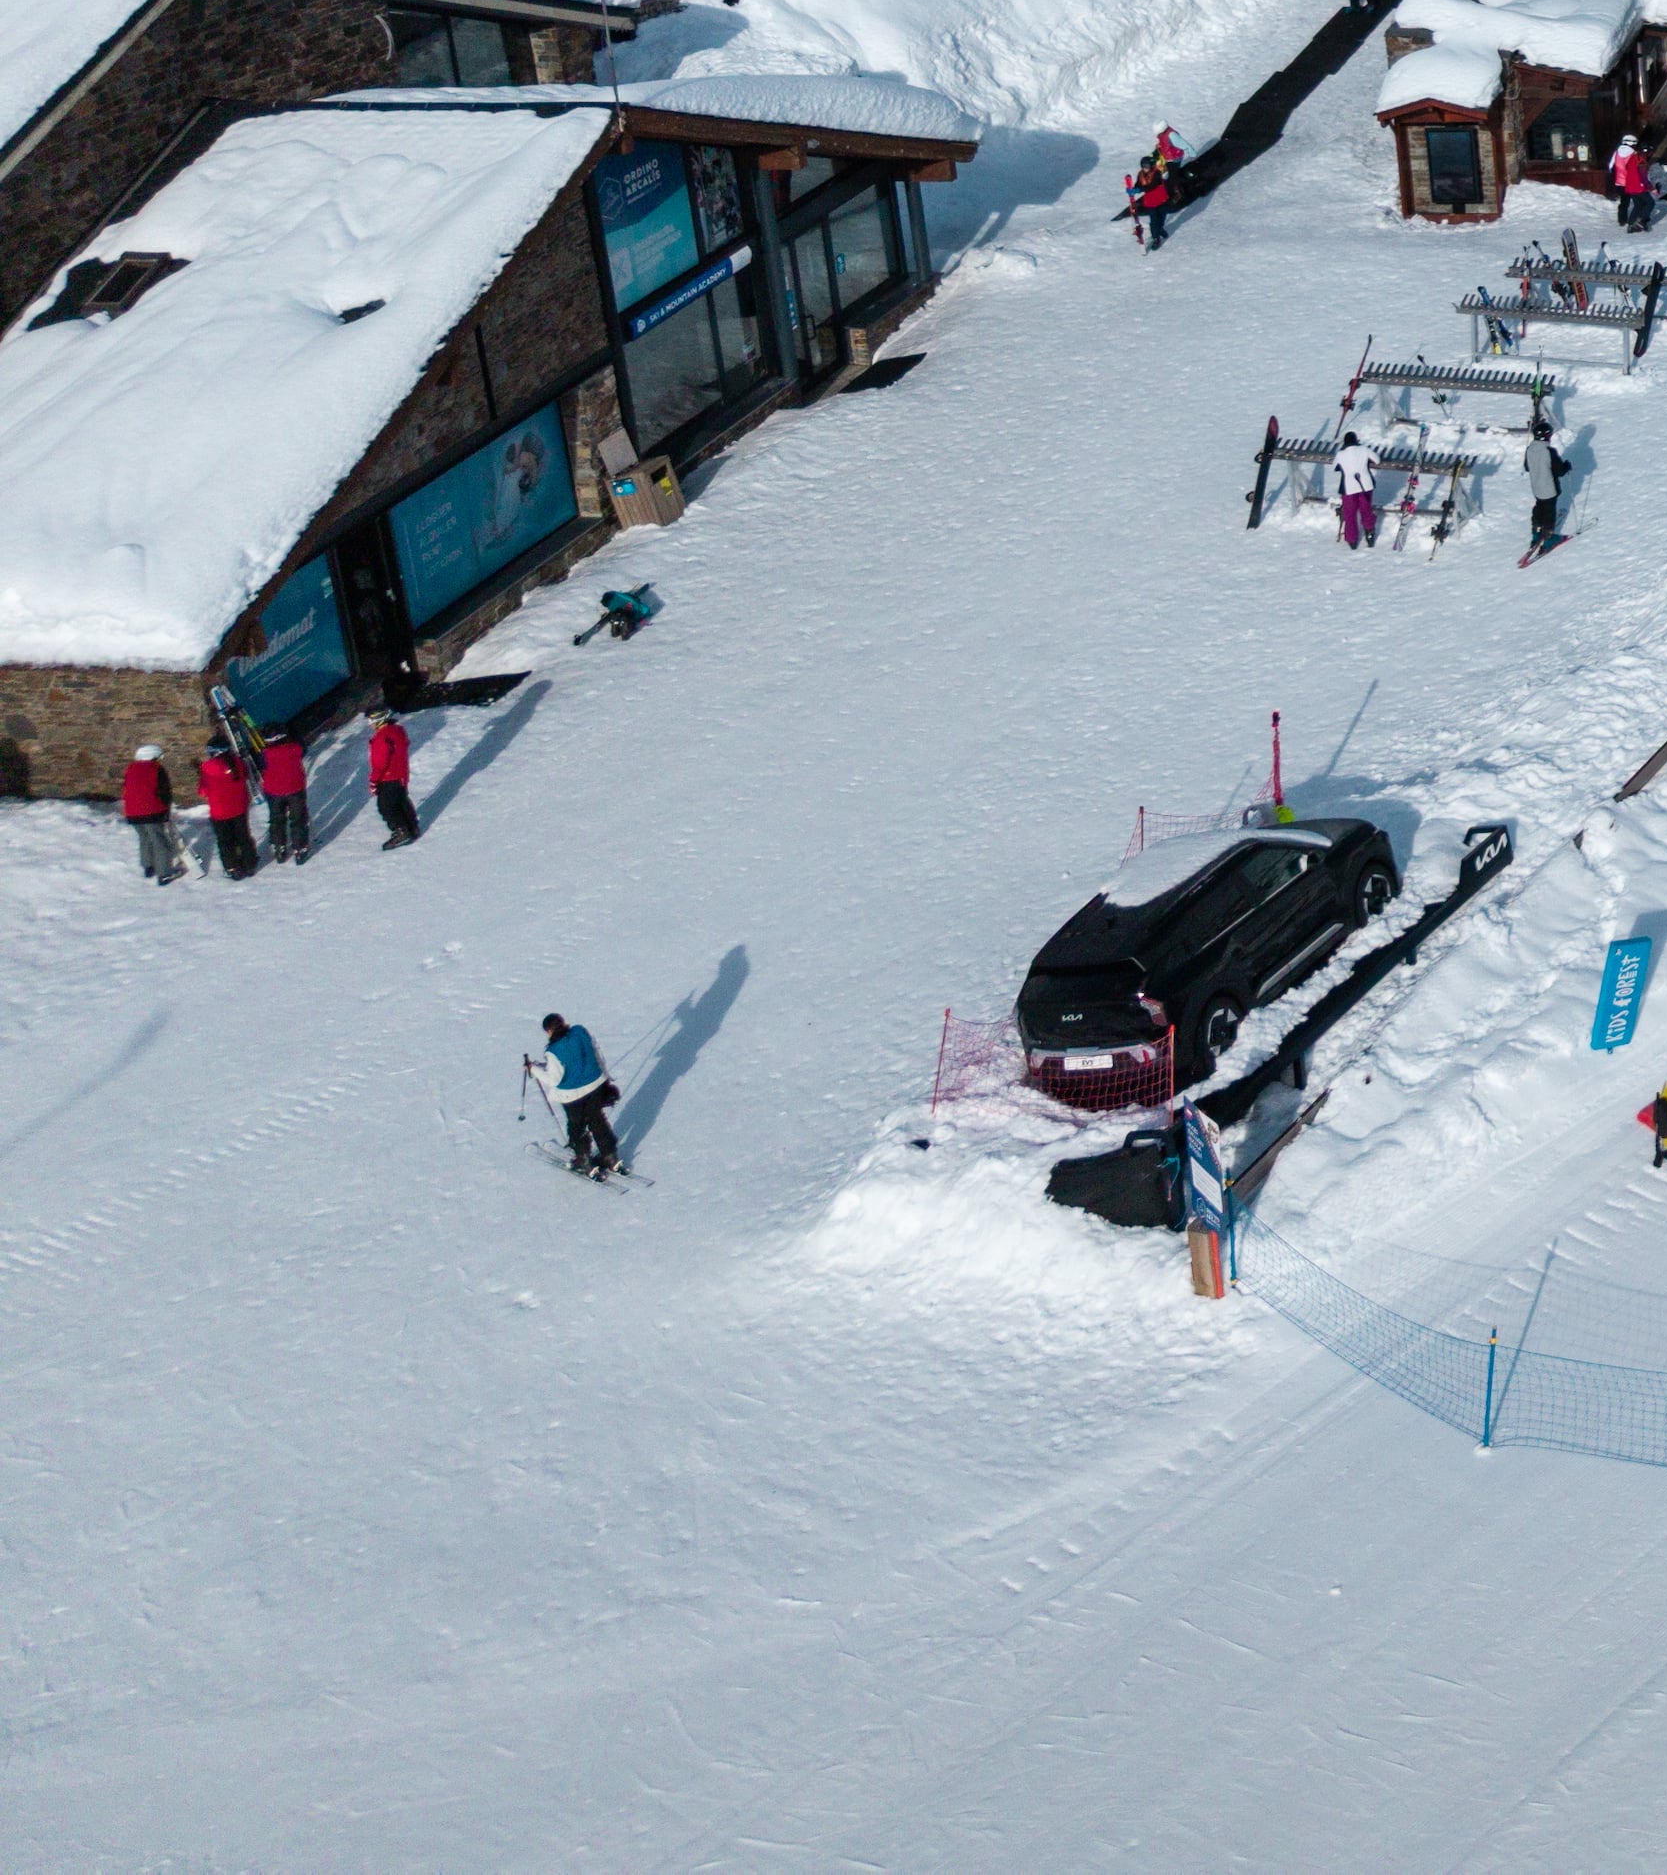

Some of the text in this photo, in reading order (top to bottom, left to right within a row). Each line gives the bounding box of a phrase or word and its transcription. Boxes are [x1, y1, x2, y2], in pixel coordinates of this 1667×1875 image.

[623, 158, 659, 185] ORDINO
[649, 313, 659, 324] SKI
[665, 287, 698, 313] MOUNTAIN
[698, 267, 727, 292] ACADEMY
[1613, 953, 1641, 1008] FOREST
[1062, 1013, 1083, 1022] KIA
